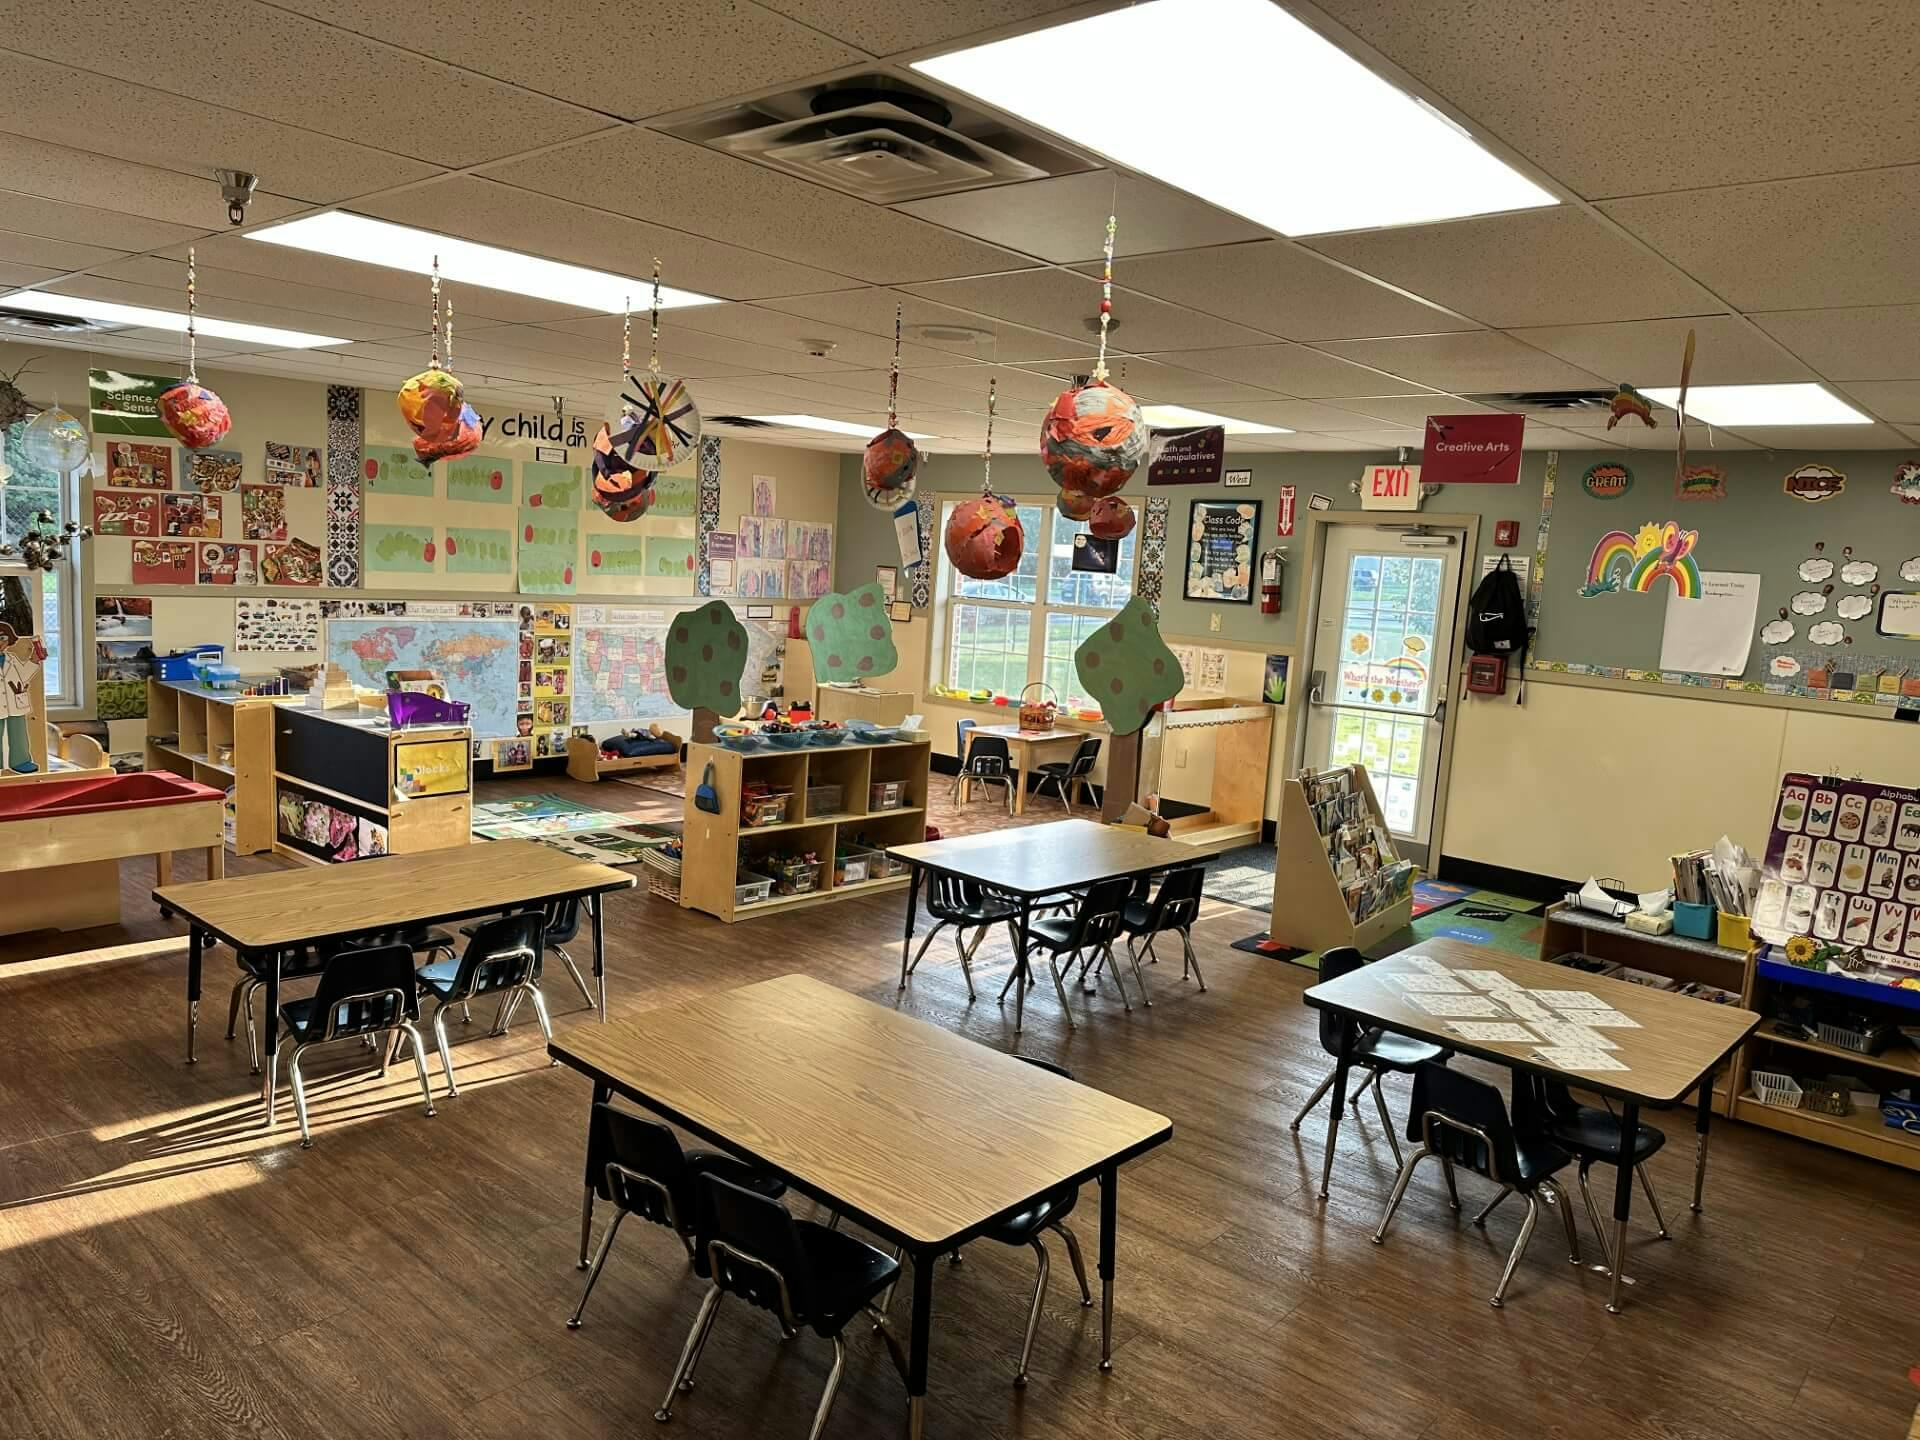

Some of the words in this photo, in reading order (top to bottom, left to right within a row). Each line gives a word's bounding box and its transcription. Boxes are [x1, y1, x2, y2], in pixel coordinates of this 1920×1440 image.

[106, 390, 153, 404] Science
[501, 412, 562, 442] child
[571, 415, 585, 435] is
[566, 433, 588, 448] an
[1435, 442, 1484, 453] Creative
[1486, 442, 1510, 452] Arts
[1158, 452, 1216, 463] Manipulatives
[1229, 474, 1249, 484] West
[1372, 468, 1410, 497] EXIT
[1586, 475, 1627, 488] GREAT!
[1791, 477, 1843, 491] NICE
[1203, 515, 1224, 525] Class
[1343, 671, 1369, 683] What's
[1385, 675, 1424, 689] Weather?
[1787, 789, 1806, 801] Aa
[1815, 793, 1833, 805] Bb
[1845, 797, 1862, 809] Cc
[1872, 801, 1894, 814] Dd
[1904, 806, 1920, 818] Ee
[1791, 838, 1806, 851] Jj
[1818, 842, 1836, 855] Kk
[1876, 852, 1898, 865] Mm
[1825, 893, 1841, 906] Tt
[1852, 898, 1873, 912] Uu
[1885, 904, 1903, 918] Vv
